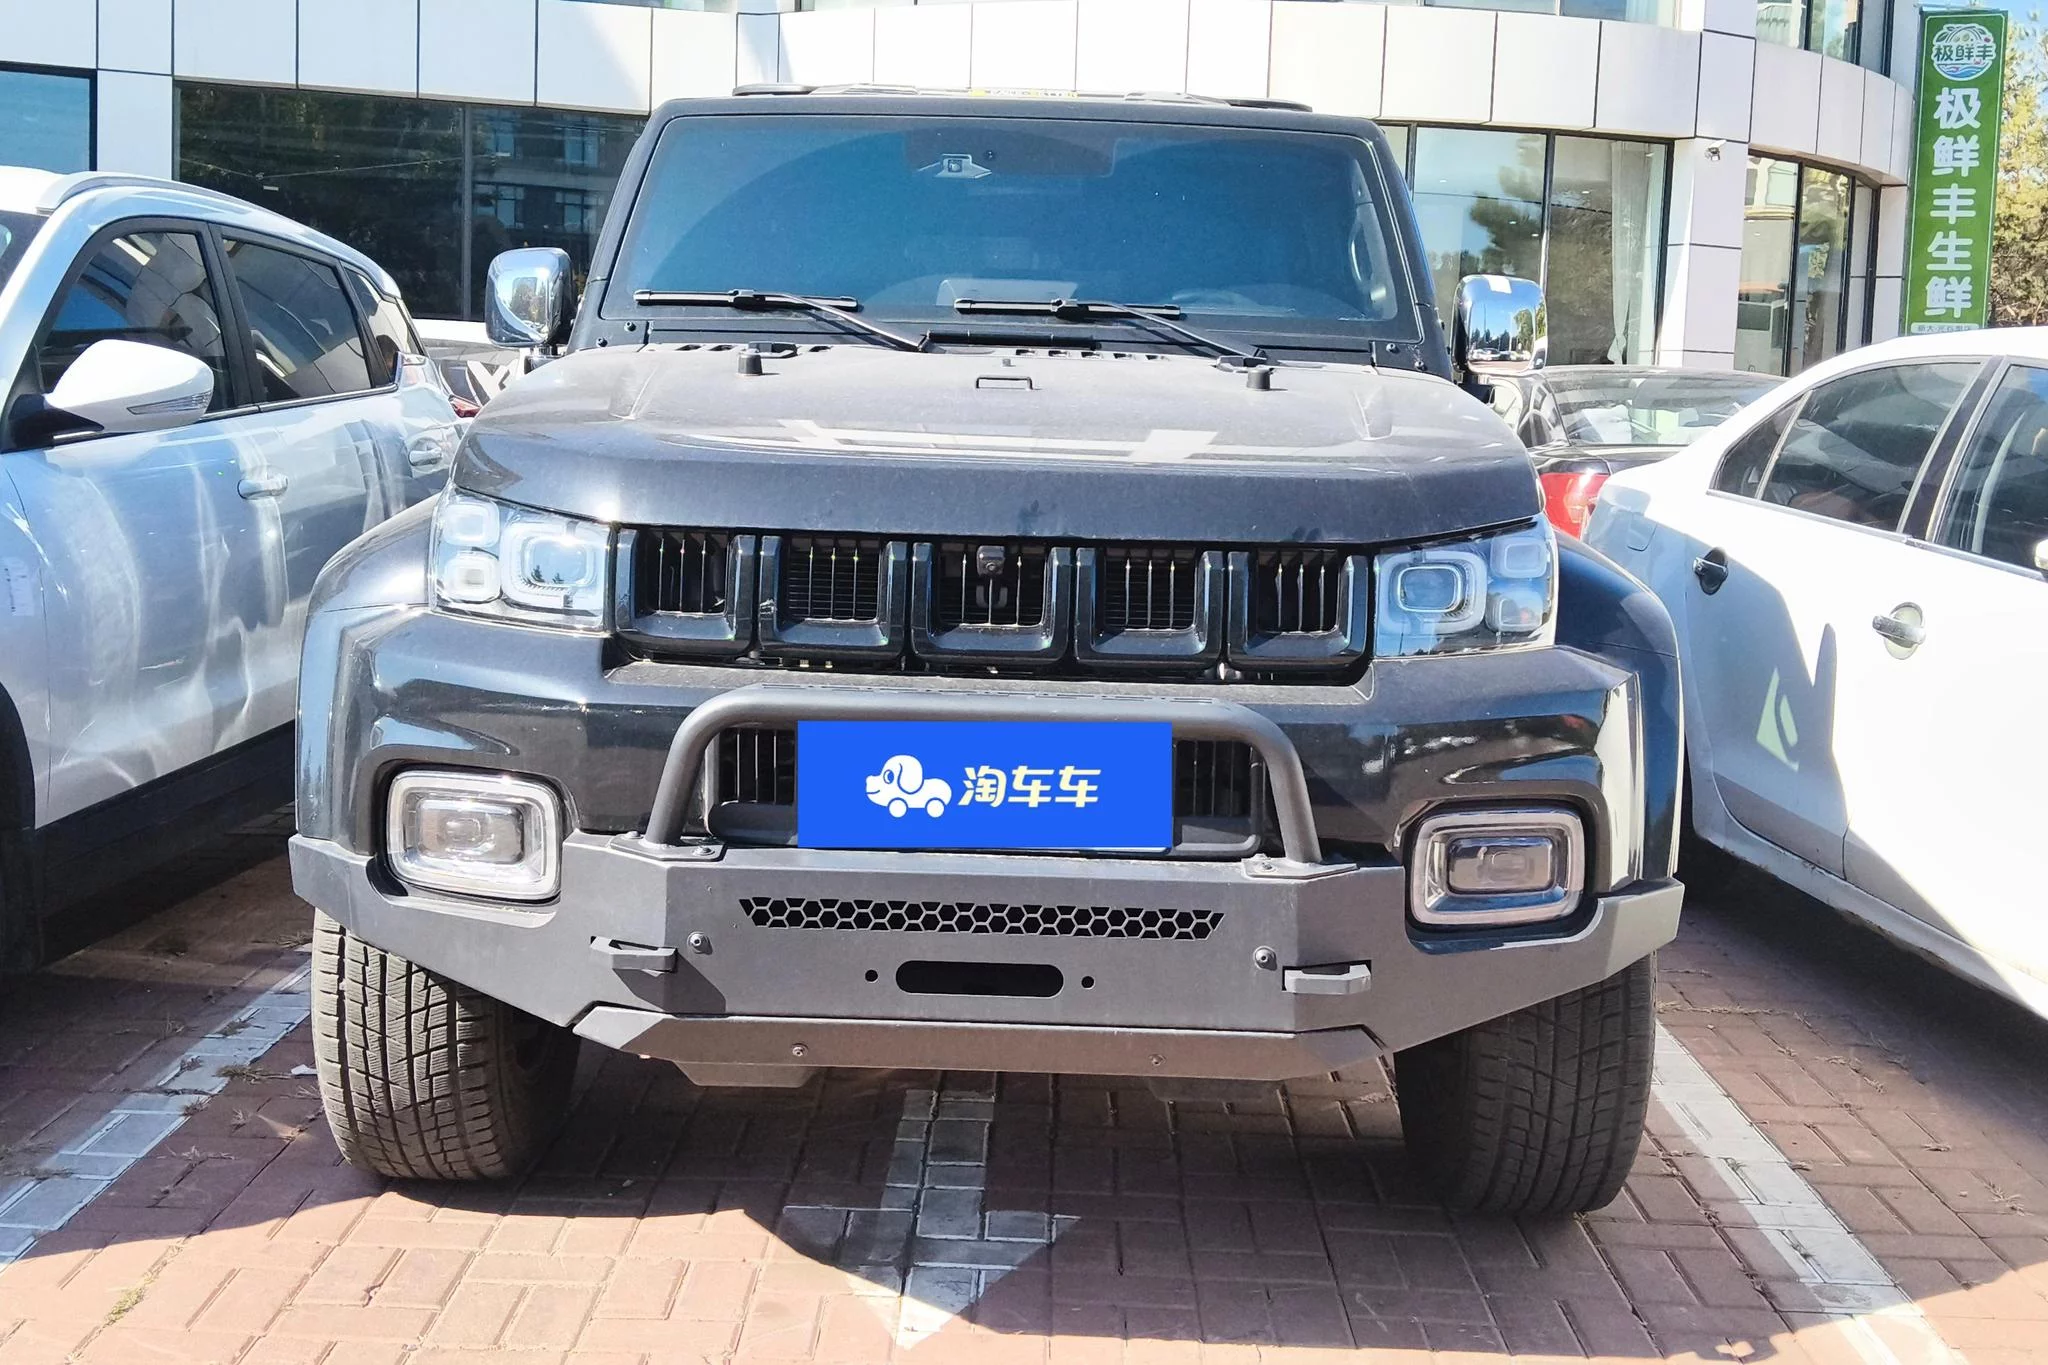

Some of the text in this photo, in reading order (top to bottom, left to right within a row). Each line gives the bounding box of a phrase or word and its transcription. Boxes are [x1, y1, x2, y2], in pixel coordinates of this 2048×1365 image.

[1934, 44, 1993, 62] 极鲜丰
[1924, 87, 1982, 319] 极鲜丰生鲜
